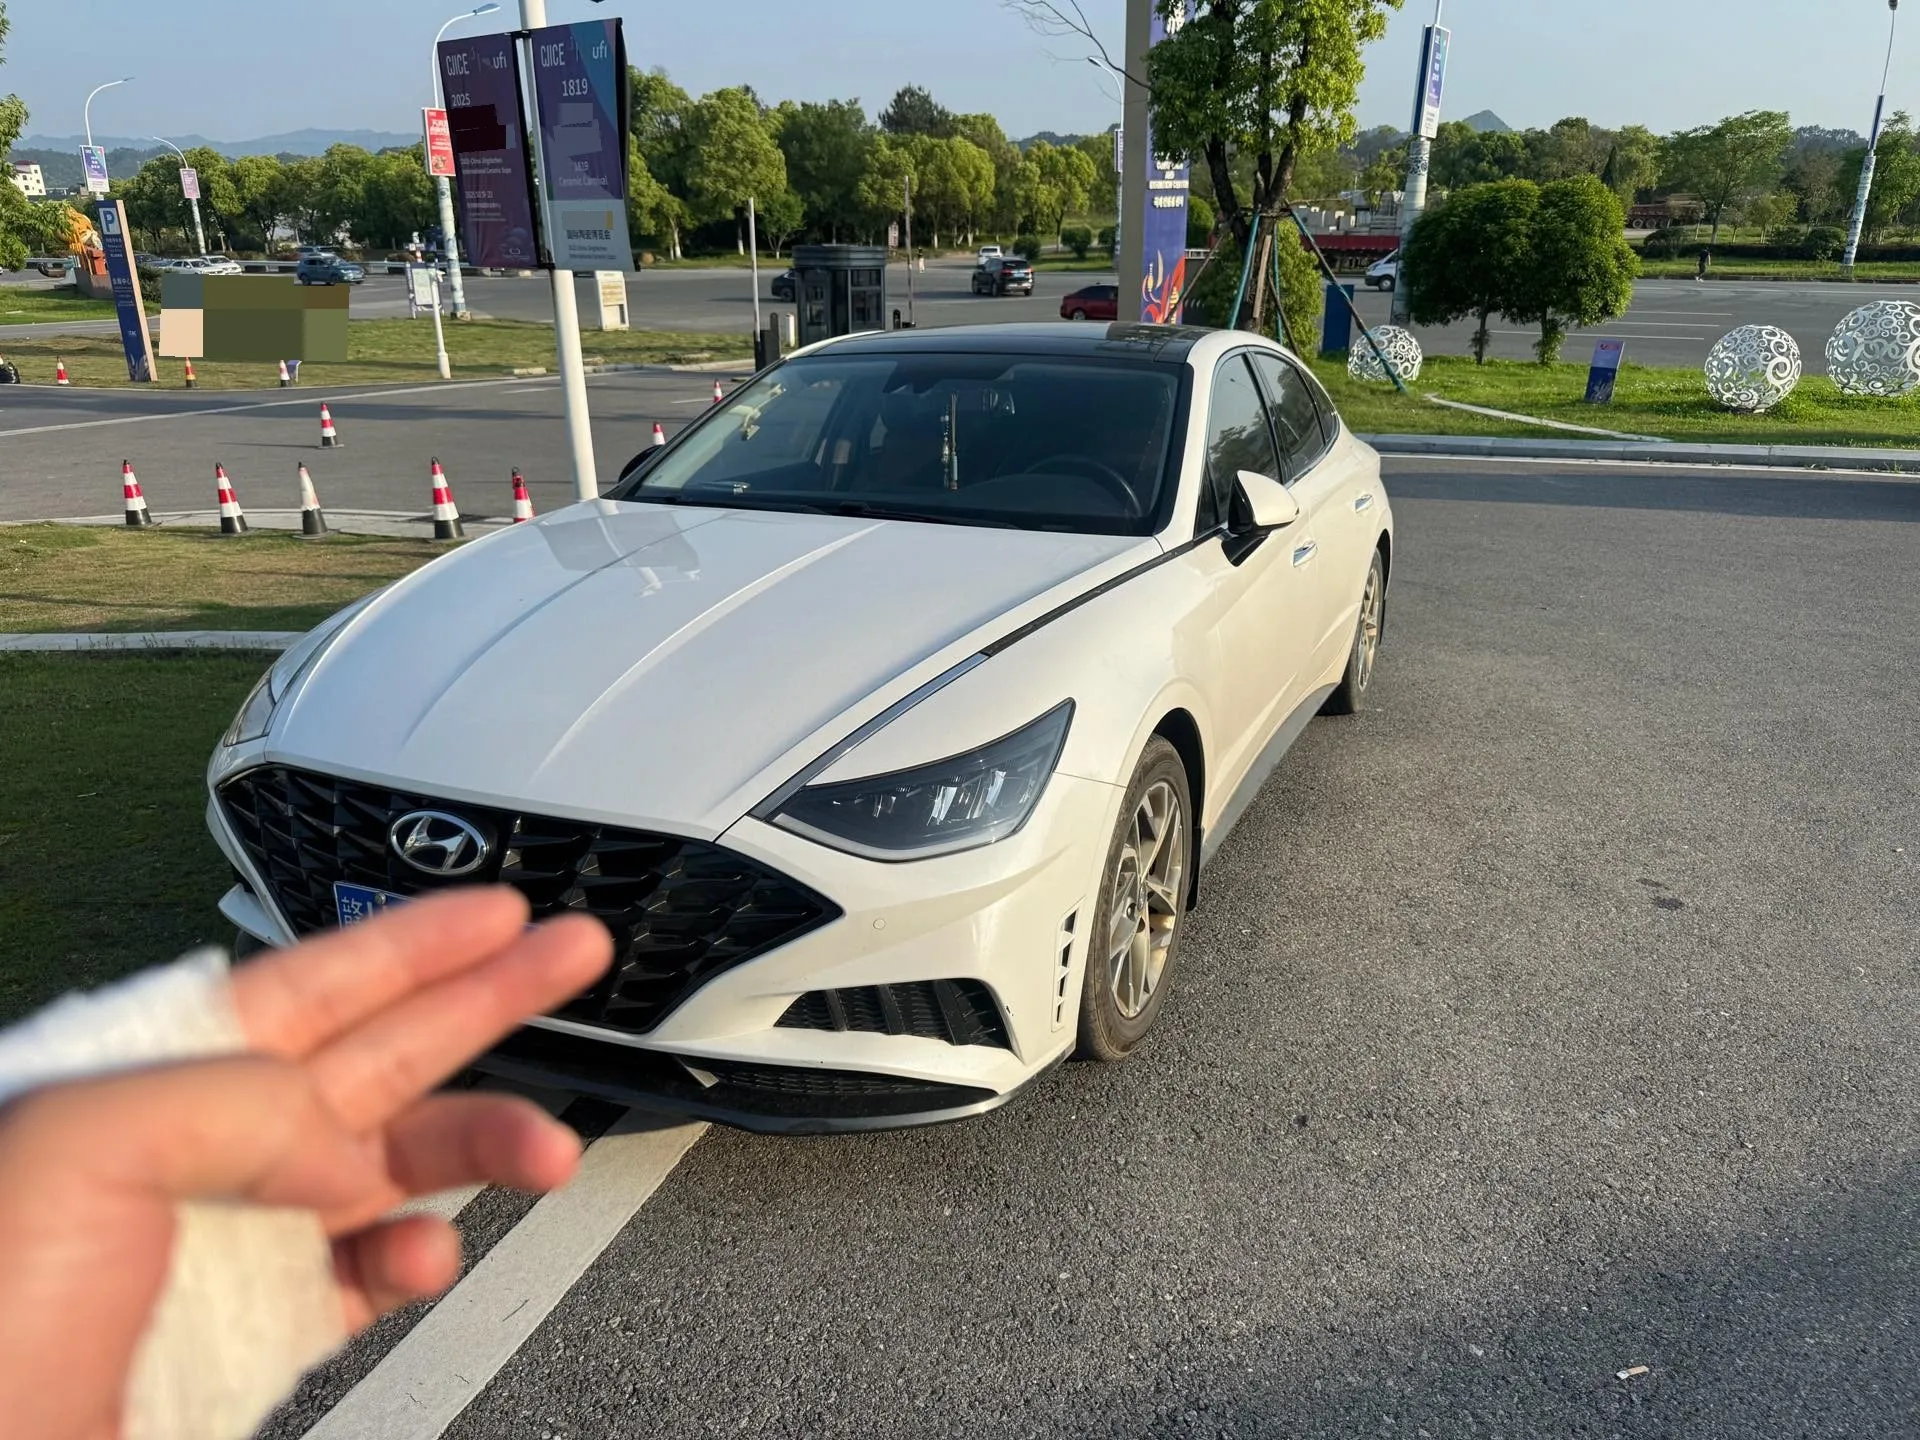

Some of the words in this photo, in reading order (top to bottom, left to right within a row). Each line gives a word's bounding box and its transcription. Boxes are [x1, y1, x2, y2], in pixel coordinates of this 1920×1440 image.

[592, 40, 608, 60] ufi
[493, 51, 507, 70] ufi
[562, 78, 588, 97] 1819
[452, 93, 471, 107] 2025
[103, 210, 115, 232] P
